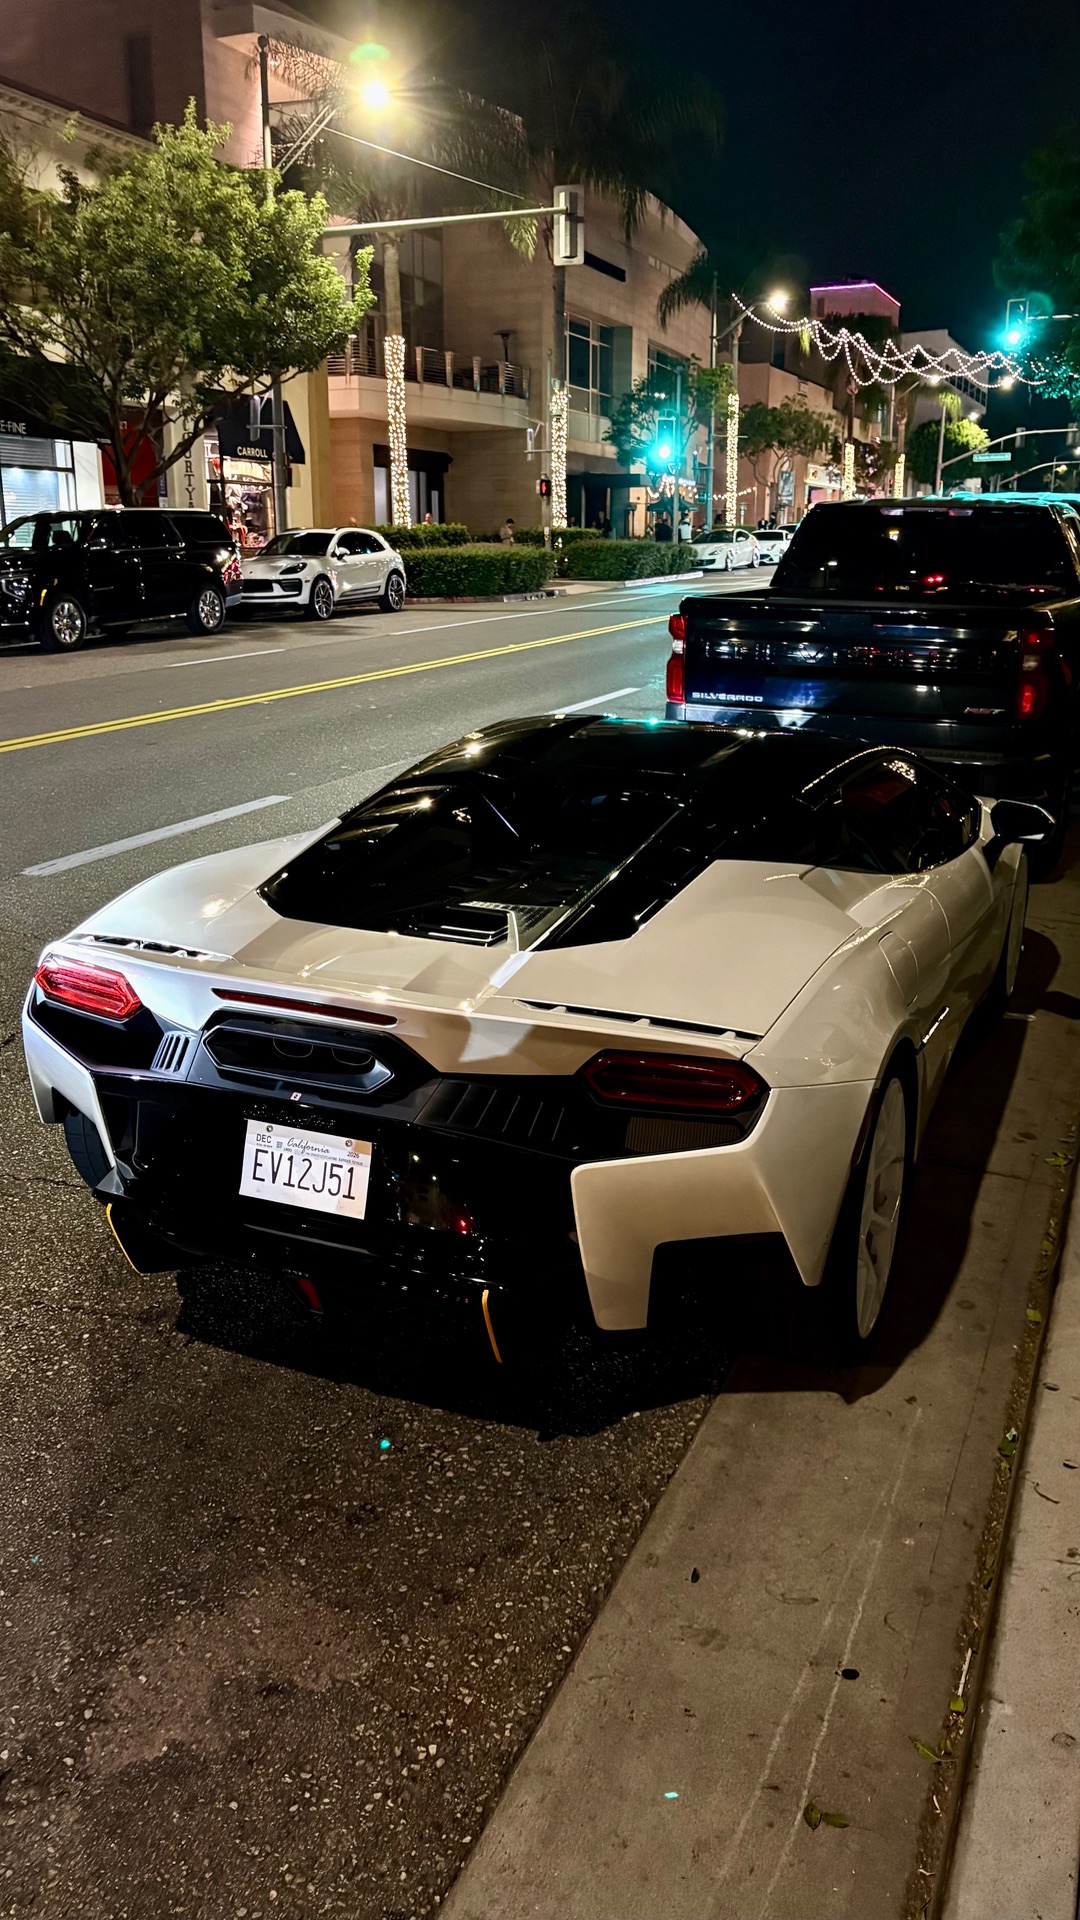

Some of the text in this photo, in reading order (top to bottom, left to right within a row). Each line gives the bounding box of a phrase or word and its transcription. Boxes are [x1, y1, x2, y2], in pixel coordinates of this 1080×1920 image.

[237, 446, 268, 458] CARROLL
[692, 691, 763, 702] SILVERADO
[256, 1133, 272, 1144] DEC
[287, 1137, 330, 1155] California
[347, 1151, 360, 1159] 2026
[252, 1148, 355, 1200] EV12J51
